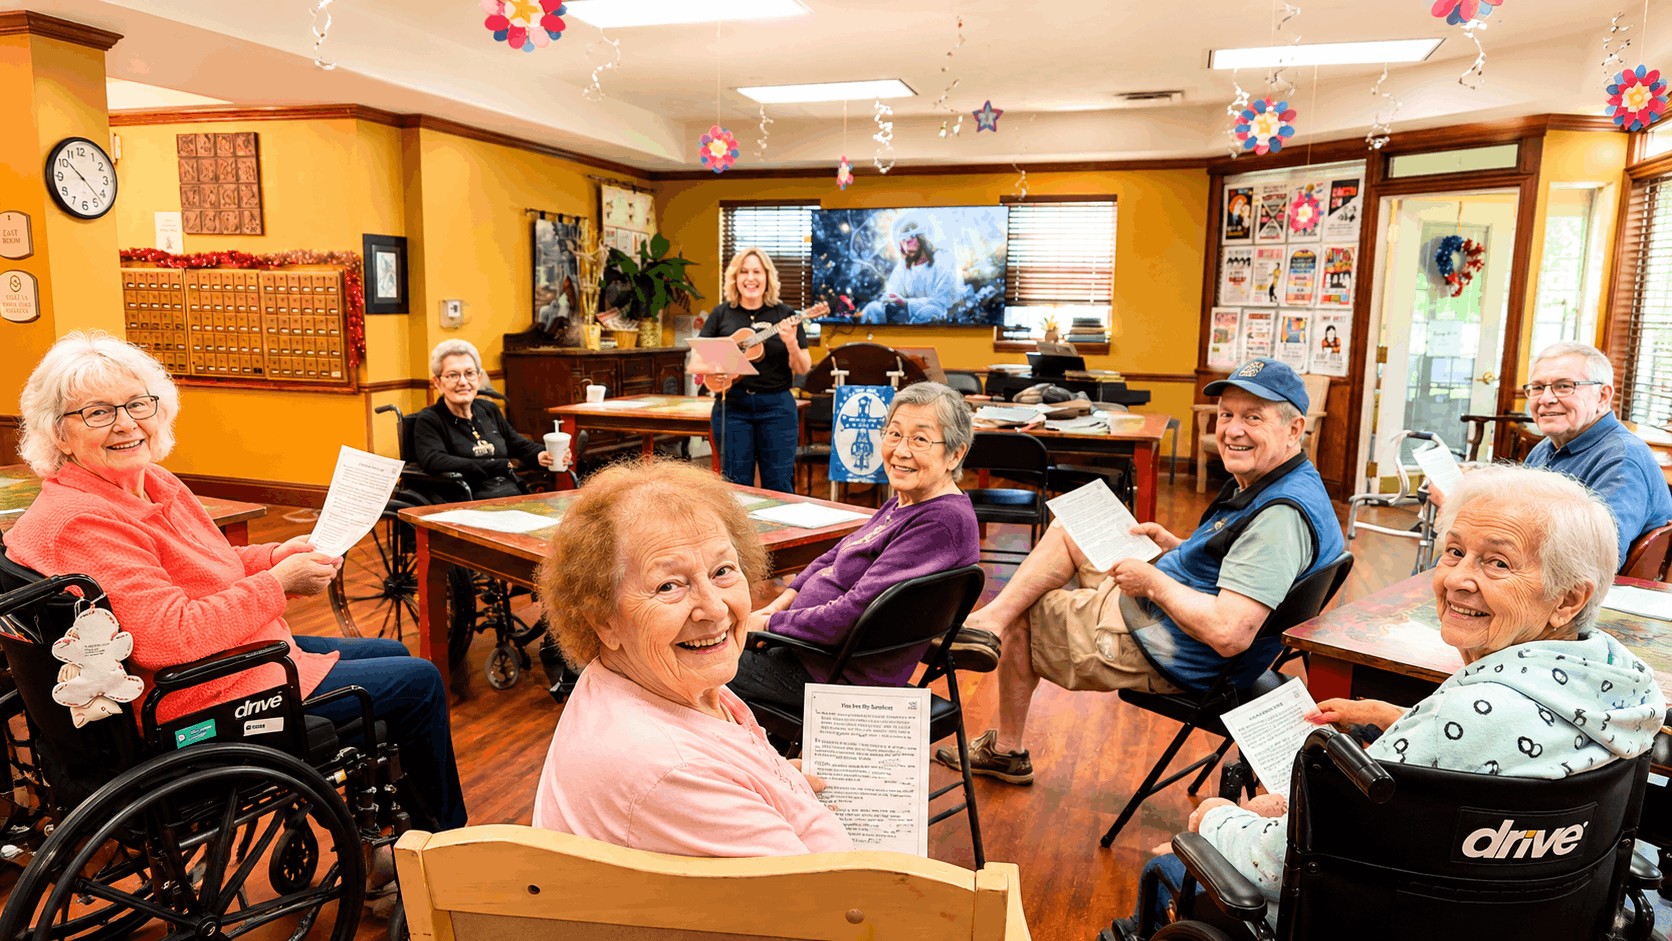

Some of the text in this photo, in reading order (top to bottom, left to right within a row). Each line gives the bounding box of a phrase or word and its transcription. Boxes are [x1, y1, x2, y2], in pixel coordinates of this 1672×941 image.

[67, 149, 74, 159] 11
[76, 147, 86, 157] 12
[58, 158, 69, 168] 10
[97, 162, 104, 172] 2
[56, 171, 64, 182] 9
[102, 176, 109, 186] 3
[61, 186, 69, 197] 8
[71, 196, 77, 205] 7
[81, 200, 89, 211] 6
[92, 197, 99, 208] 5
[234, 694, 283, 719] drive
[1461, 819, 1584, 859] drive
